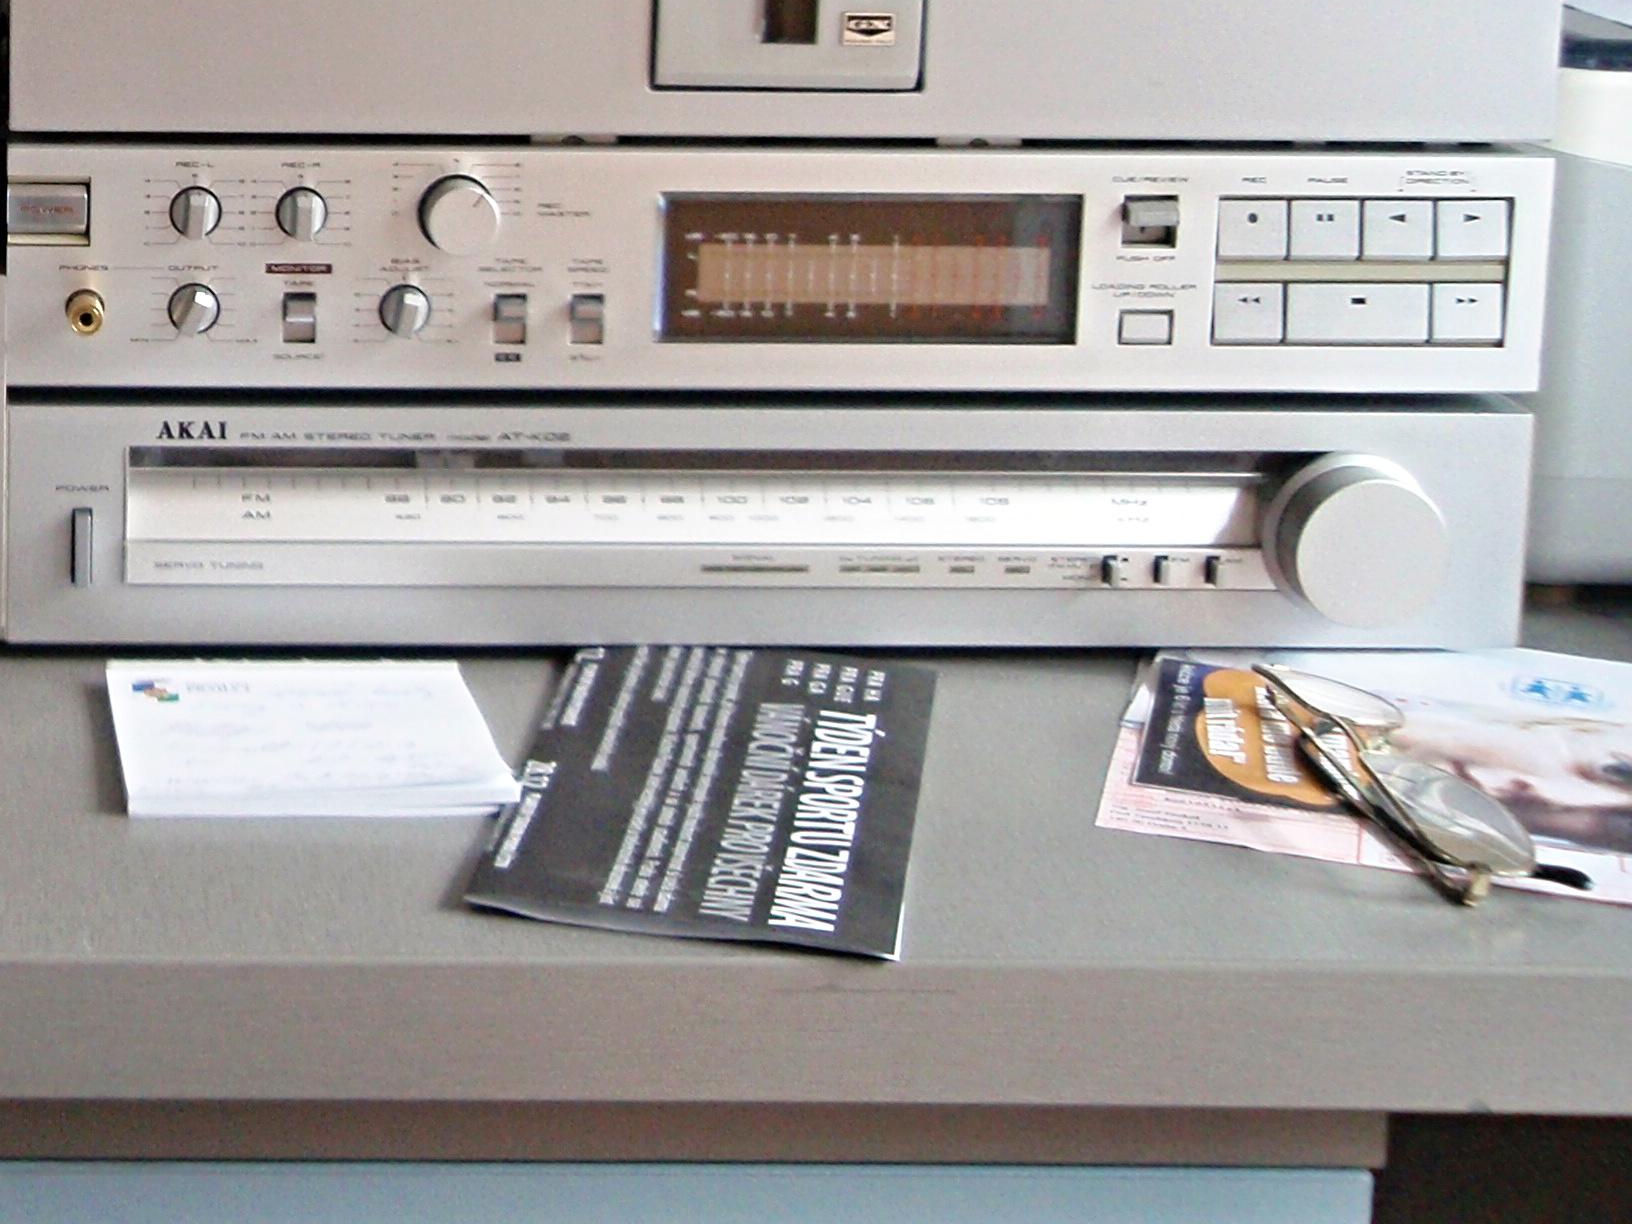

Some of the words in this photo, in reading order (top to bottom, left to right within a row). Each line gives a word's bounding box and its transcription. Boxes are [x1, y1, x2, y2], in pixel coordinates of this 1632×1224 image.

[156, 421, 228, 439] AKAI
[240, 432, 265, 440] FM
[271, 432, 296, 440] AM
[242, 494, 270, 502] FM
[718, 496, 748, 504] 100
[745, 702, 810, 770] VÁNOČNÍ
[809, 710, 885, 772] TÝDEN
[730, 770, 795, 819] DÁREK
[790, 772, 864, 846] SPORTU
[721, 819, 770, 853] PRO
[698, 853, 773, 922] VŠECHNY
[768, 847, 851, 932] ZDARMA
